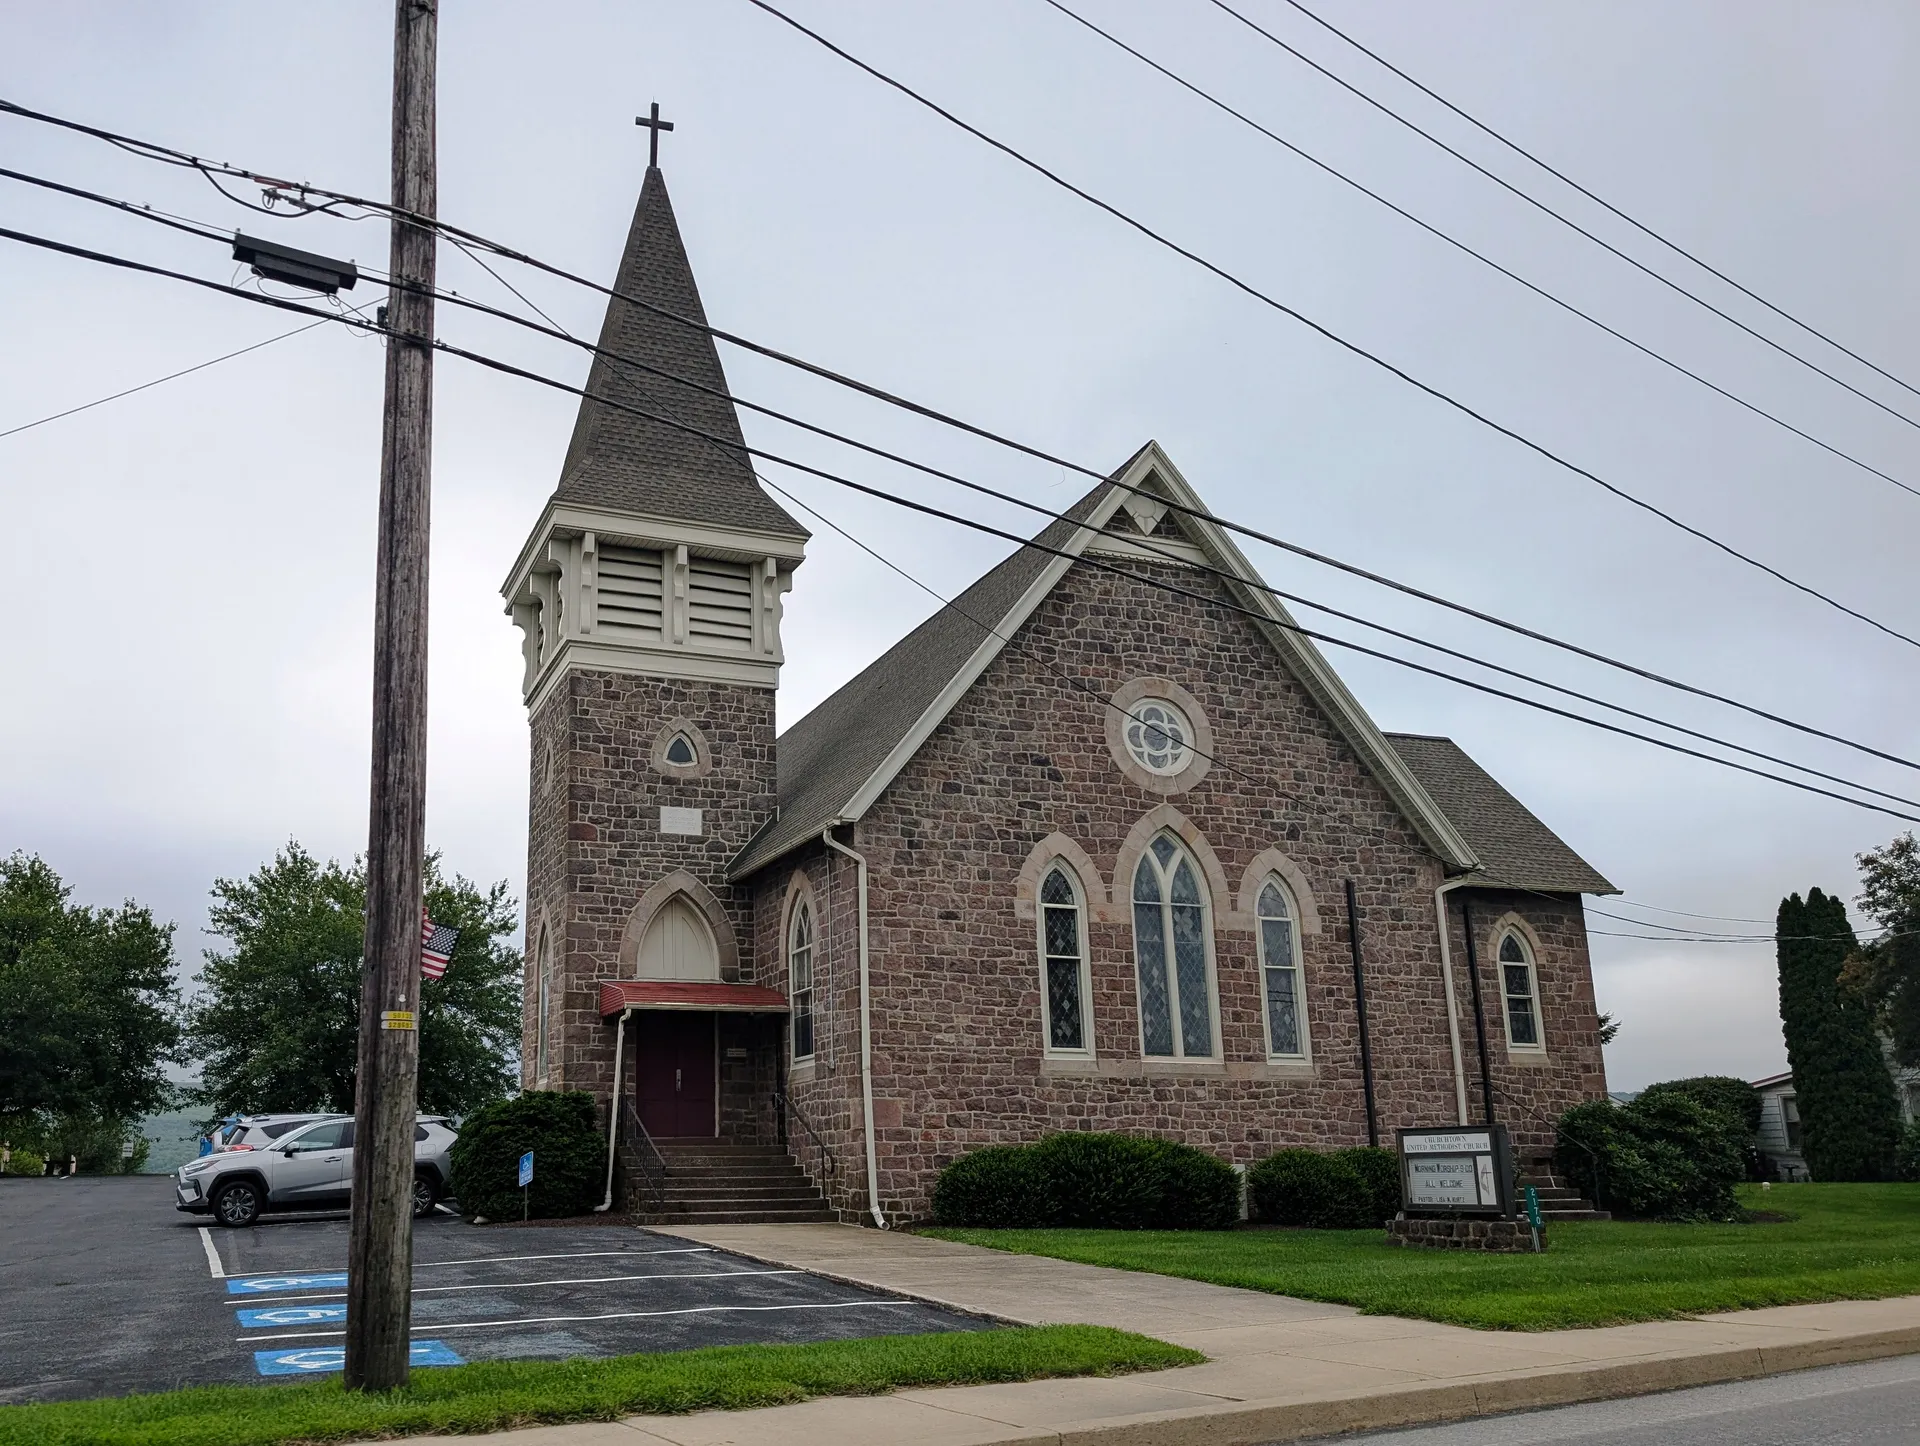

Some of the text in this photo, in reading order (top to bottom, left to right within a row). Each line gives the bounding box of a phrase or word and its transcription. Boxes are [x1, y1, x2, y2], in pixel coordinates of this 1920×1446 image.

[1425, 1180, 1463, 1188] ALL WELCOME
[1530, 1188, 1540, 1224] 2170
